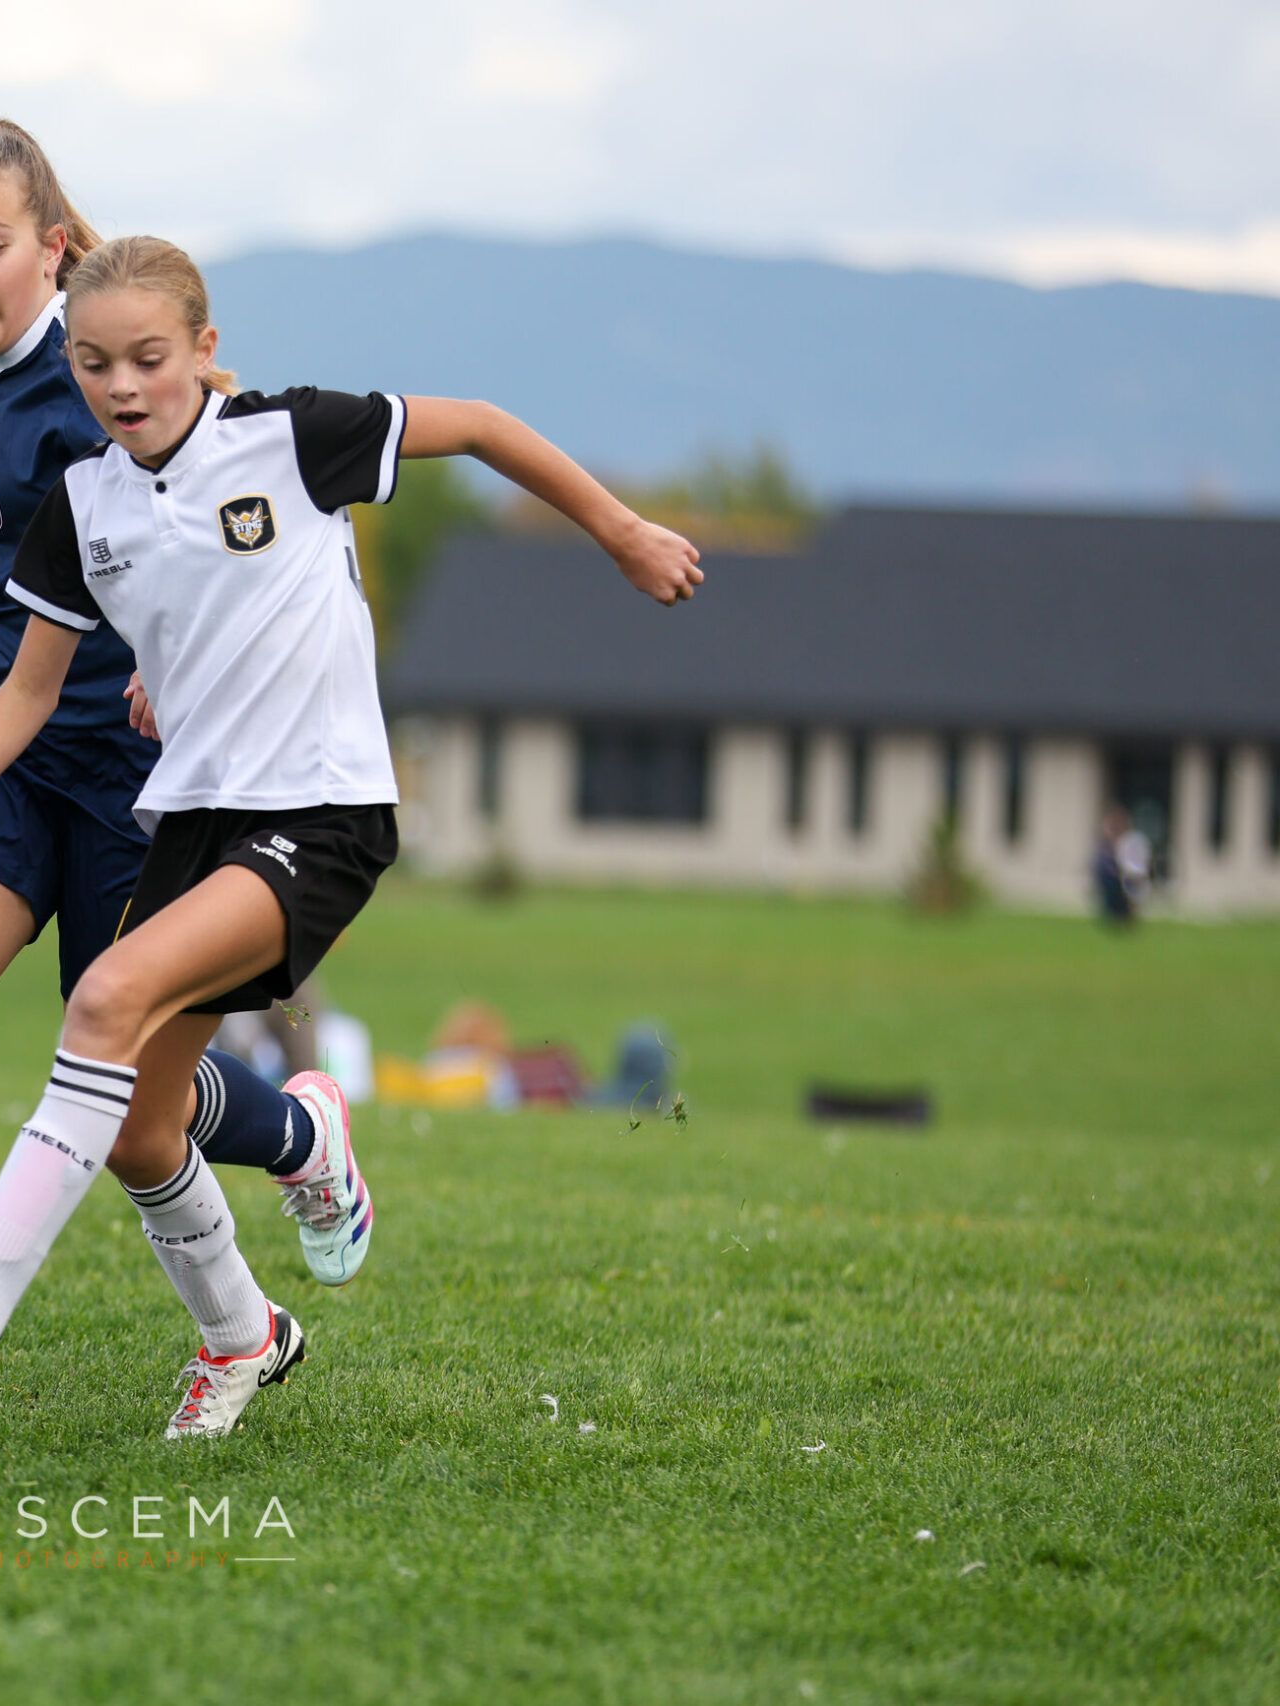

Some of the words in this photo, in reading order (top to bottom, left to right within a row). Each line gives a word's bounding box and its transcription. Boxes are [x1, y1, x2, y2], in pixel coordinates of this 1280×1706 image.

[87, 560, 133, 580] TREBLE
[21, 1127, 96, 1171] TREBLE
[145, 1216, 223, 1246] TREBLE
